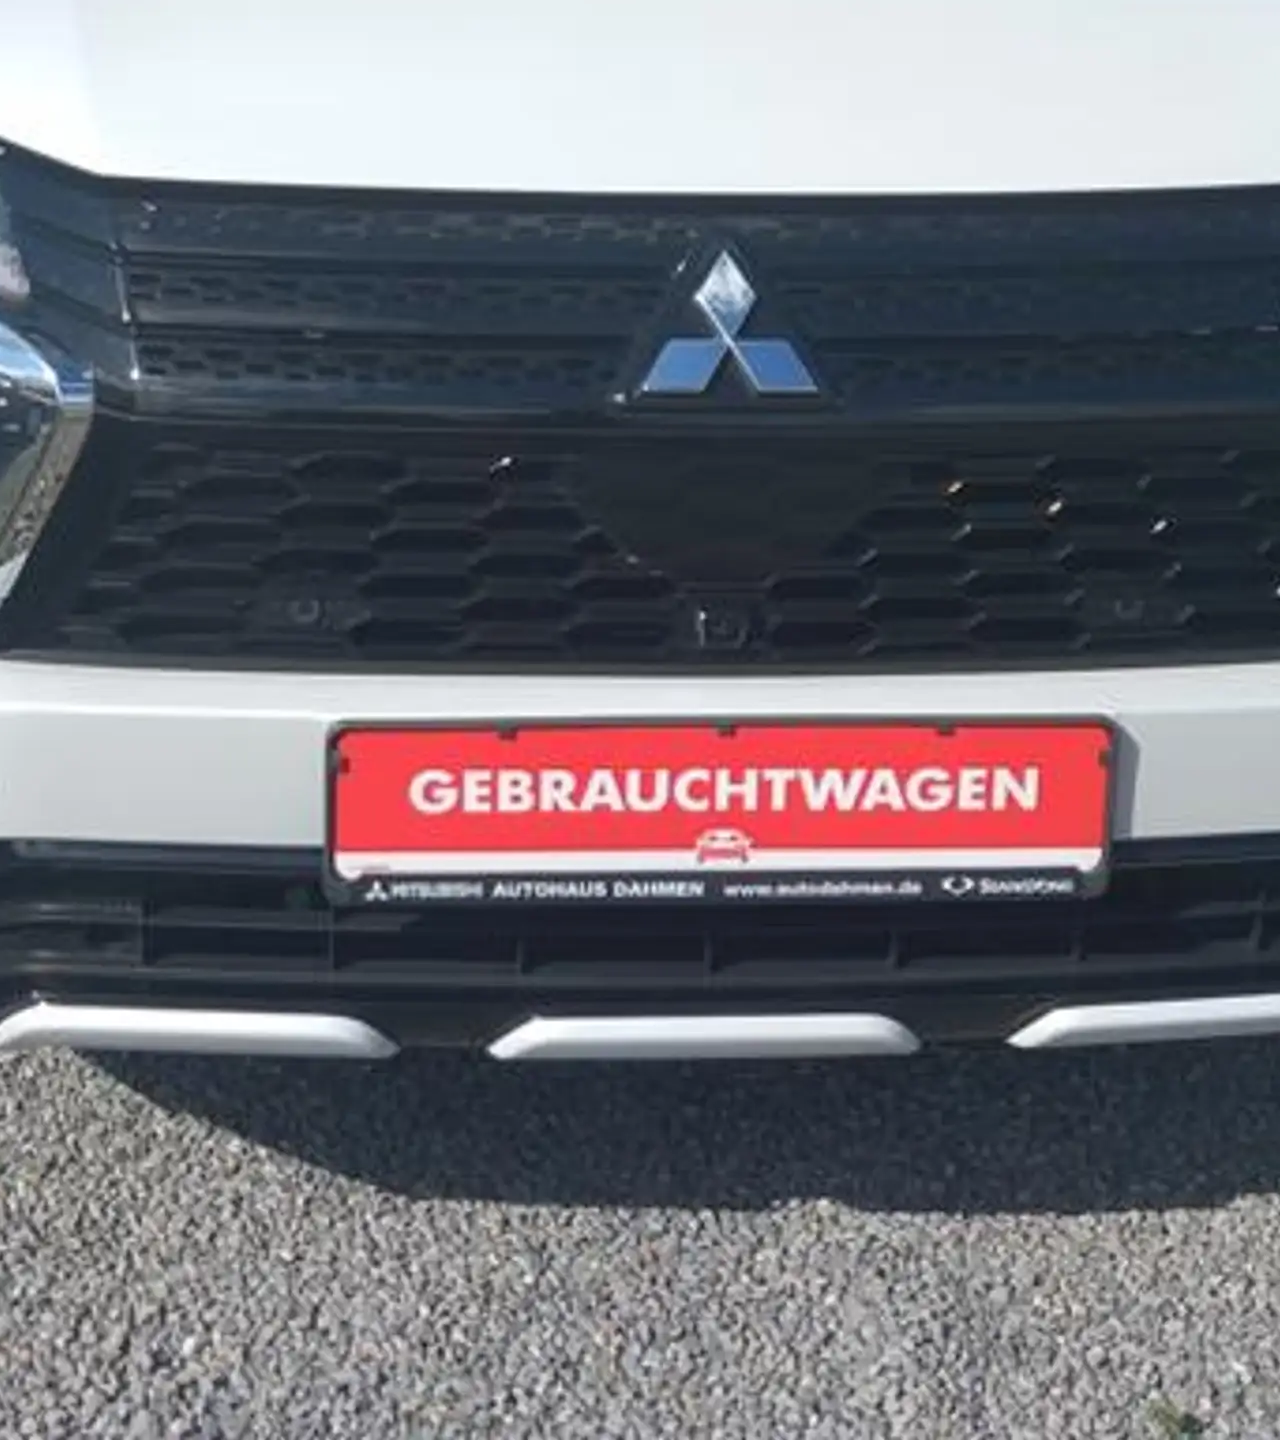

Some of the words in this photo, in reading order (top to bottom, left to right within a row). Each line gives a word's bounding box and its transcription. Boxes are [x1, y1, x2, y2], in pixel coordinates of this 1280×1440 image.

[408, 767, 1040, 814] GEBRAUCHTWAGEN
[492, 880, 608, 899] AUTOHAUS
[613, 880, 706, 899] DAHMEN
